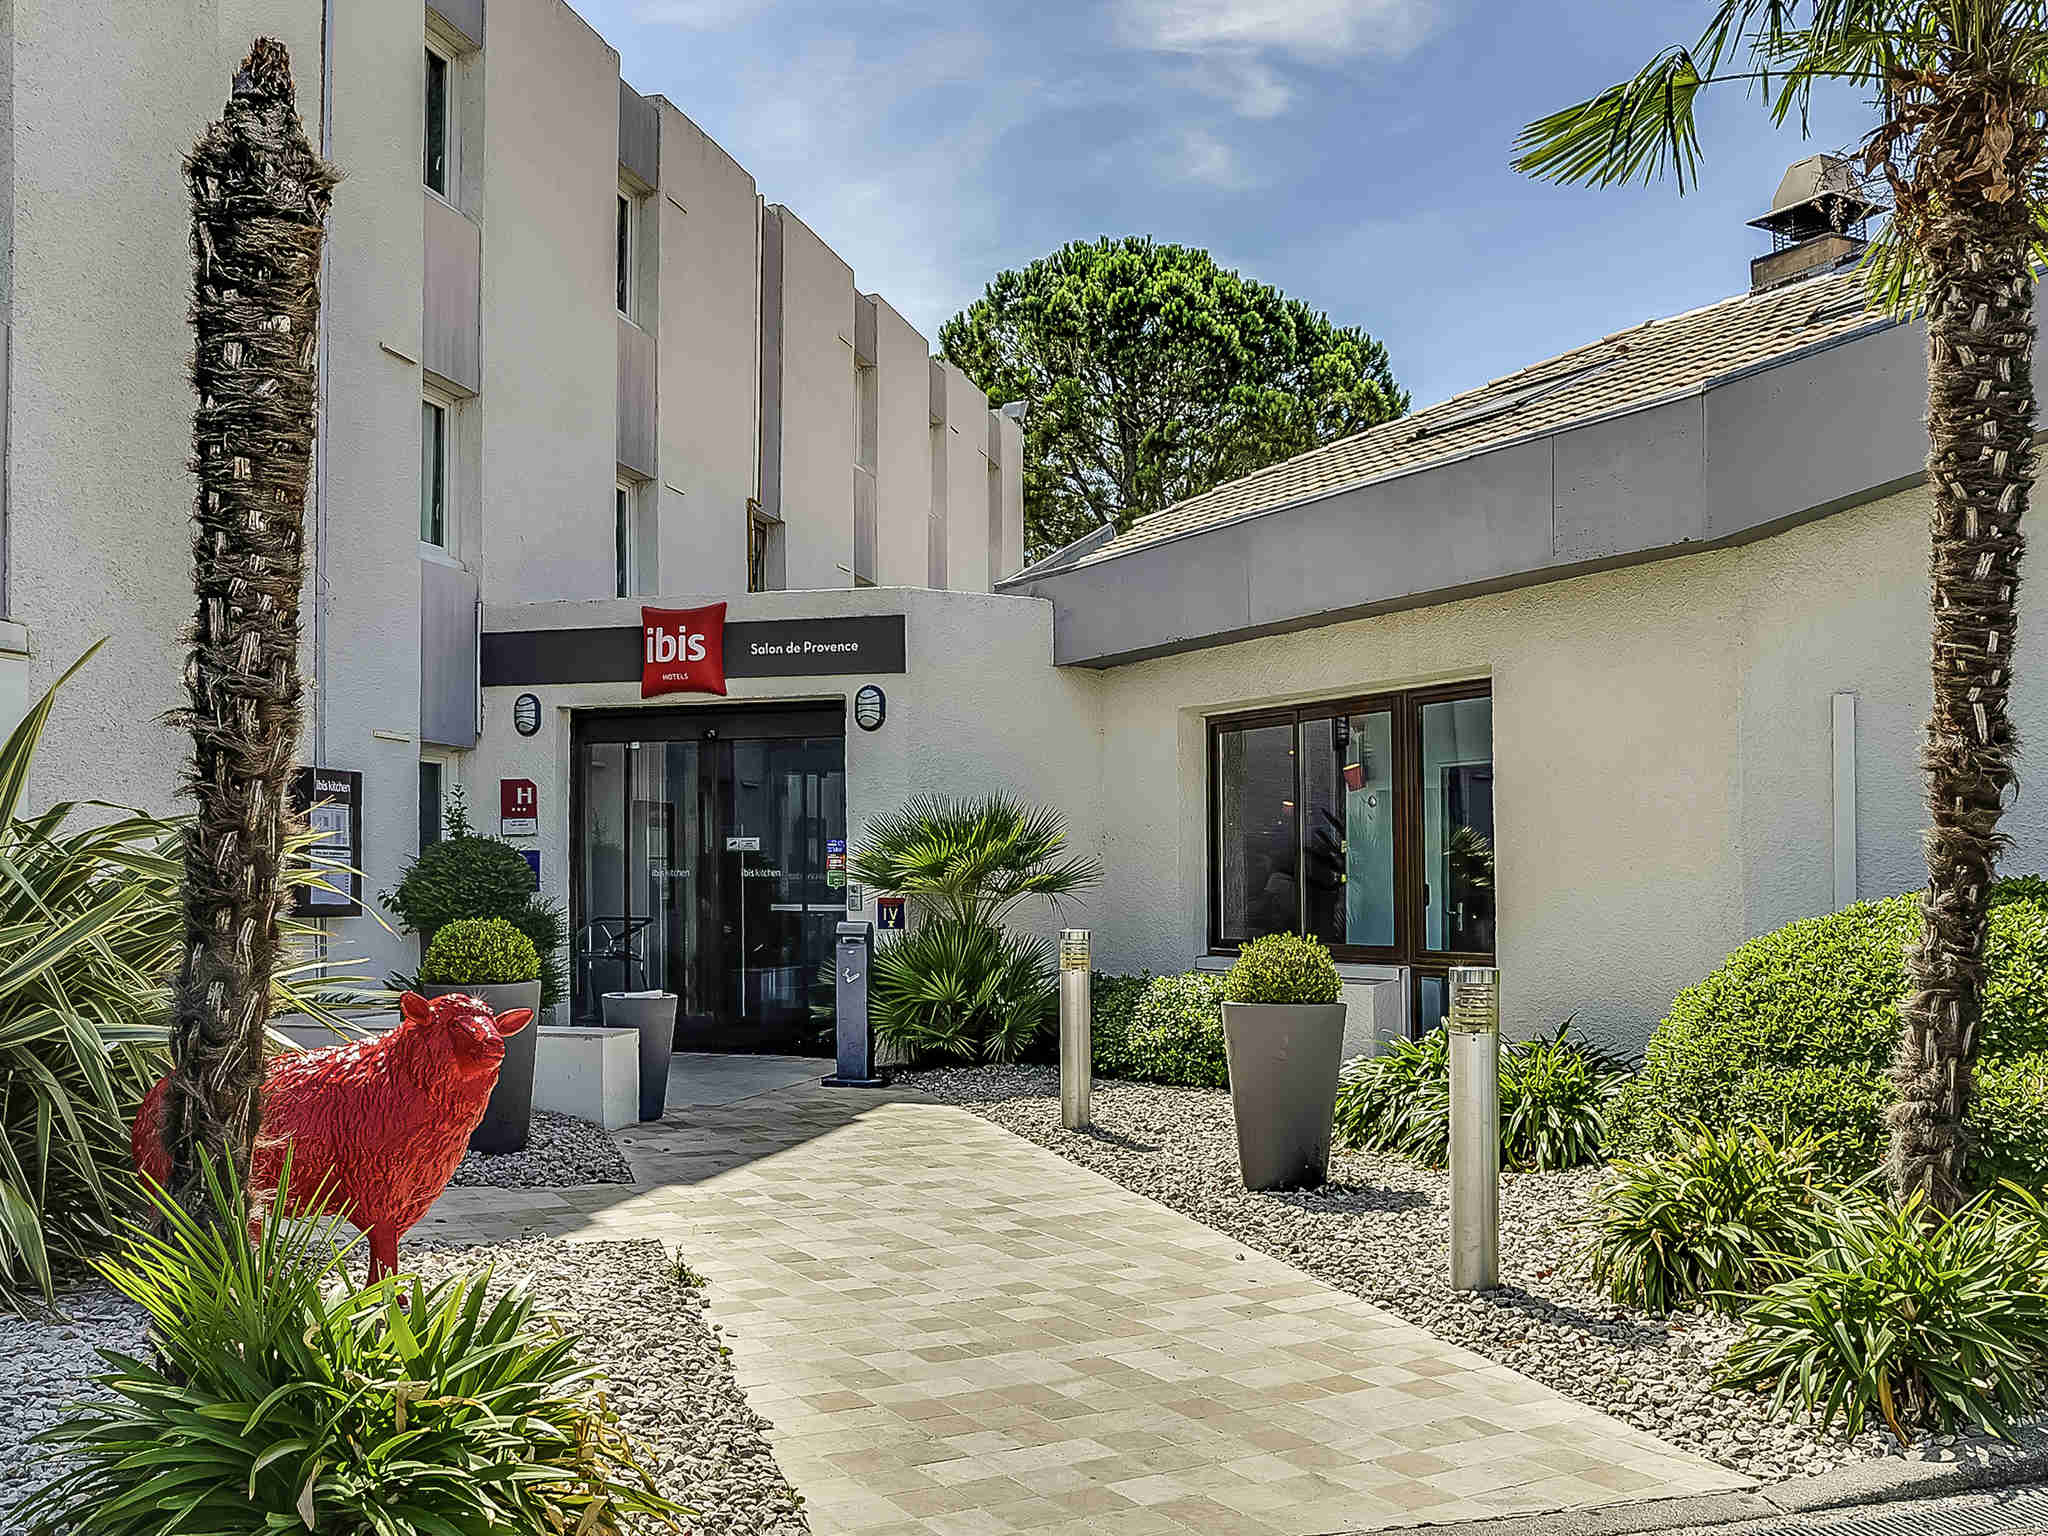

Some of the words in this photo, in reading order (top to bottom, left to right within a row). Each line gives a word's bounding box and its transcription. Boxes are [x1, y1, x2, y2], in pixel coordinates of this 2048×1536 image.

[647, 625, 706, 664] ibis
[750, 642, 783, 655] Salon
[785, 641, 801, 654] de
[803, 640, 859, 654] Provence
[662, 672, 689, 680] HOTELS
[517, 787, 532, 804] H
